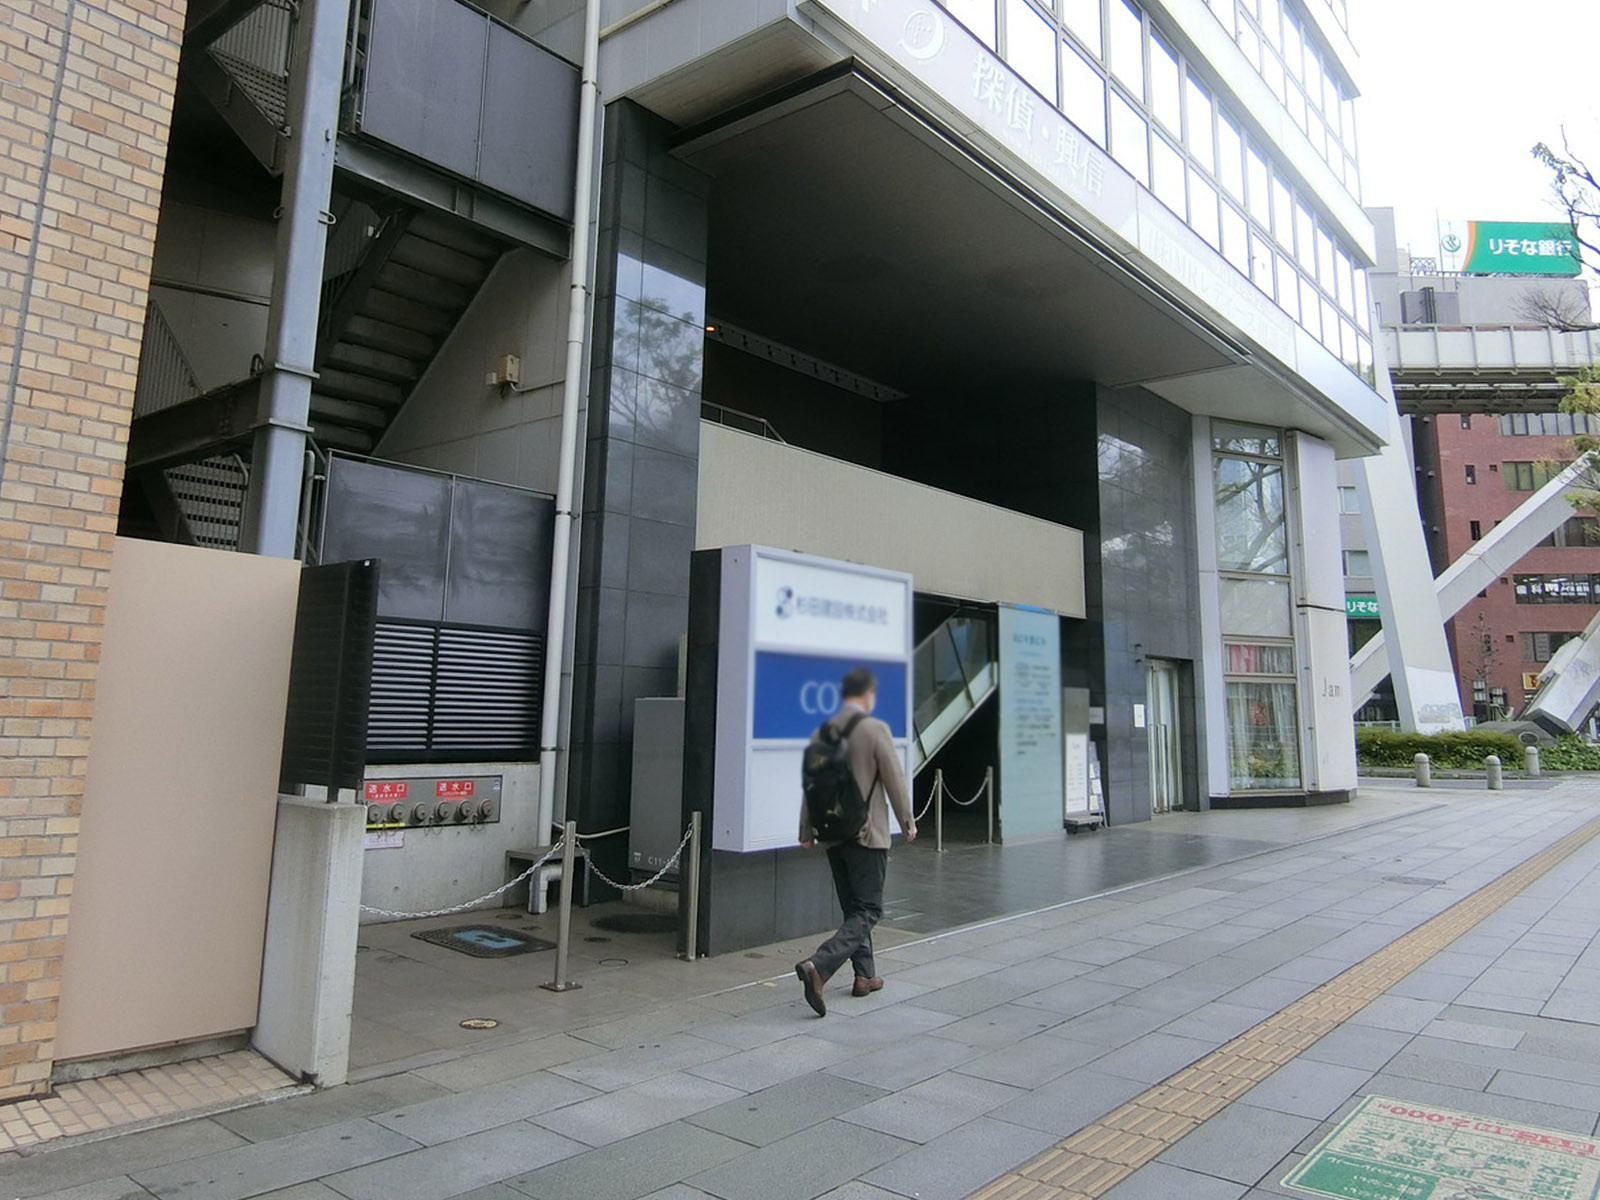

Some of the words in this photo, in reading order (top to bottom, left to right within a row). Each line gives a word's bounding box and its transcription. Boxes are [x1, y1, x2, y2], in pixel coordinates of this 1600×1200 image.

[972, 50, 1105, 197] 探偵・興信
[1488, 238, 1572, 256] りそな銀行
[799, 680, 842, 715] CO
[368, 783, 405, 794] 送水口
[439, 781, 472, 793] 送水口
